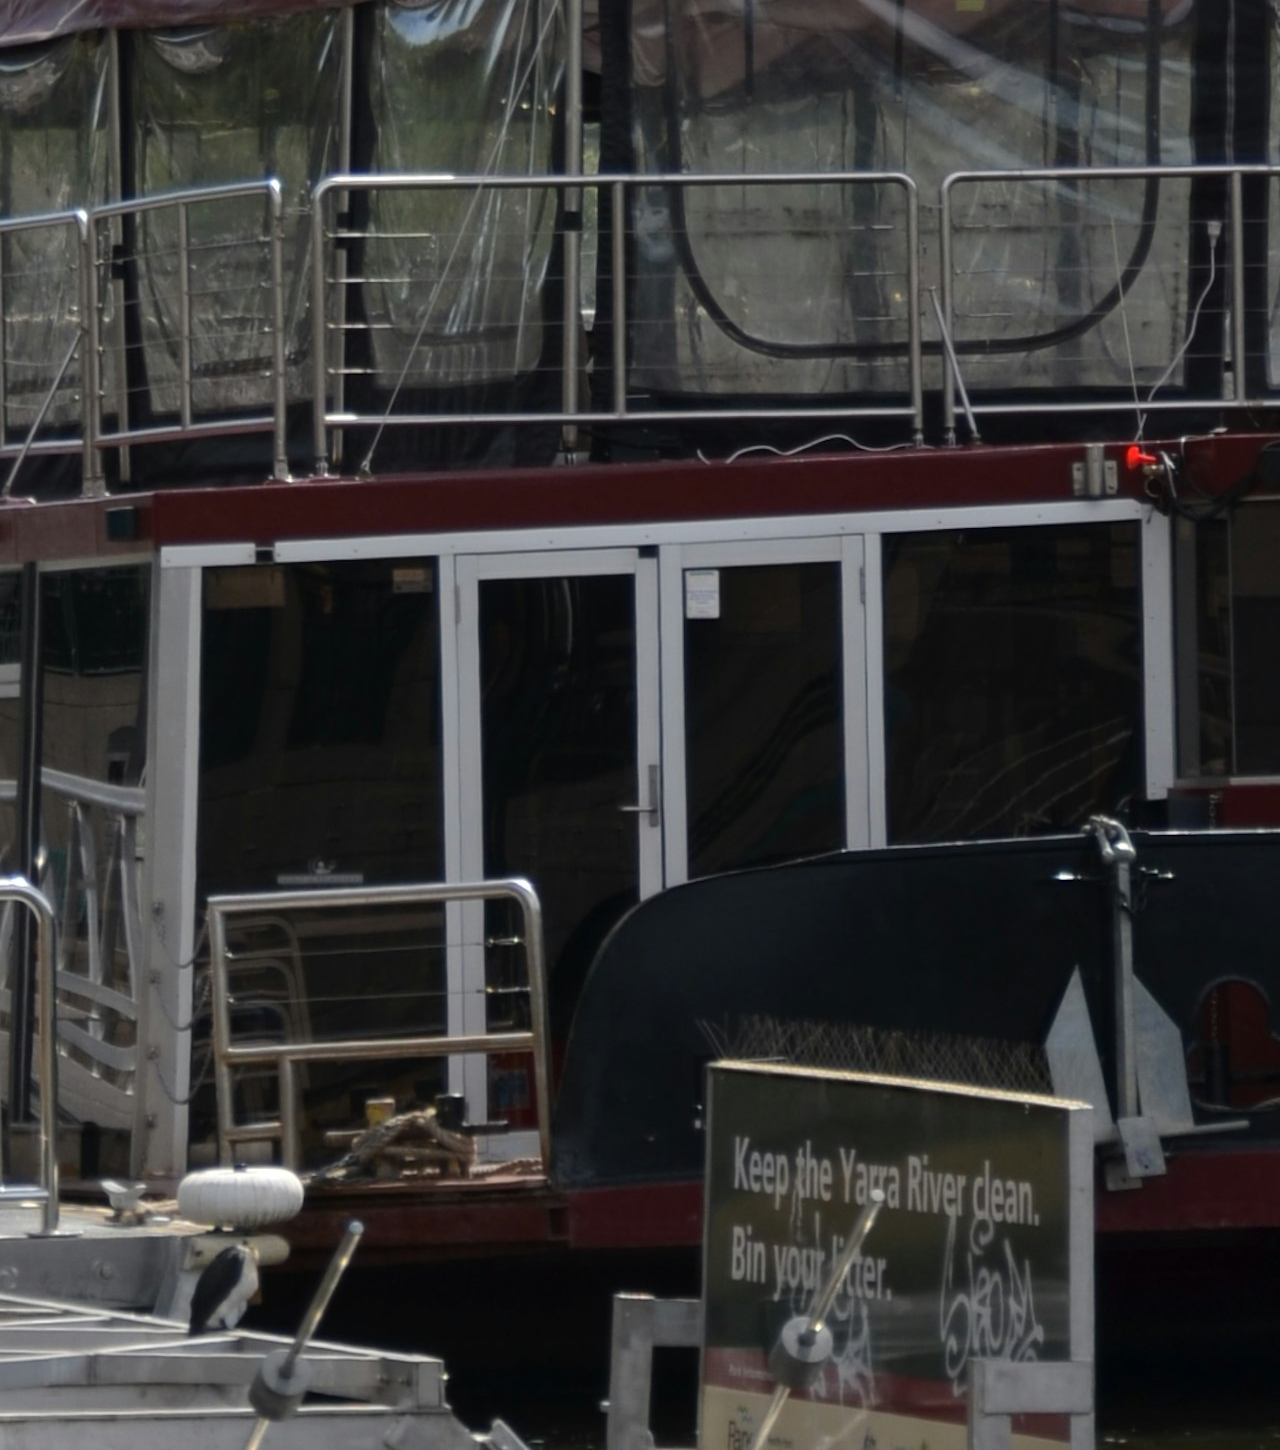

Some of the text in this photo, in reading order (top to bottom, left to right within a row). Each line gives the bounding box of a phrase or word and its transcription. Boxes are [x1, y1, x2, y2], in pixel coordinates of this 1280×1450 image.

[733, 1135, 1040, 1227] Keep the Yarra River clean.
[731, 1225, 766, 1284] Bin
[773, 1244, 825, 1302] your
